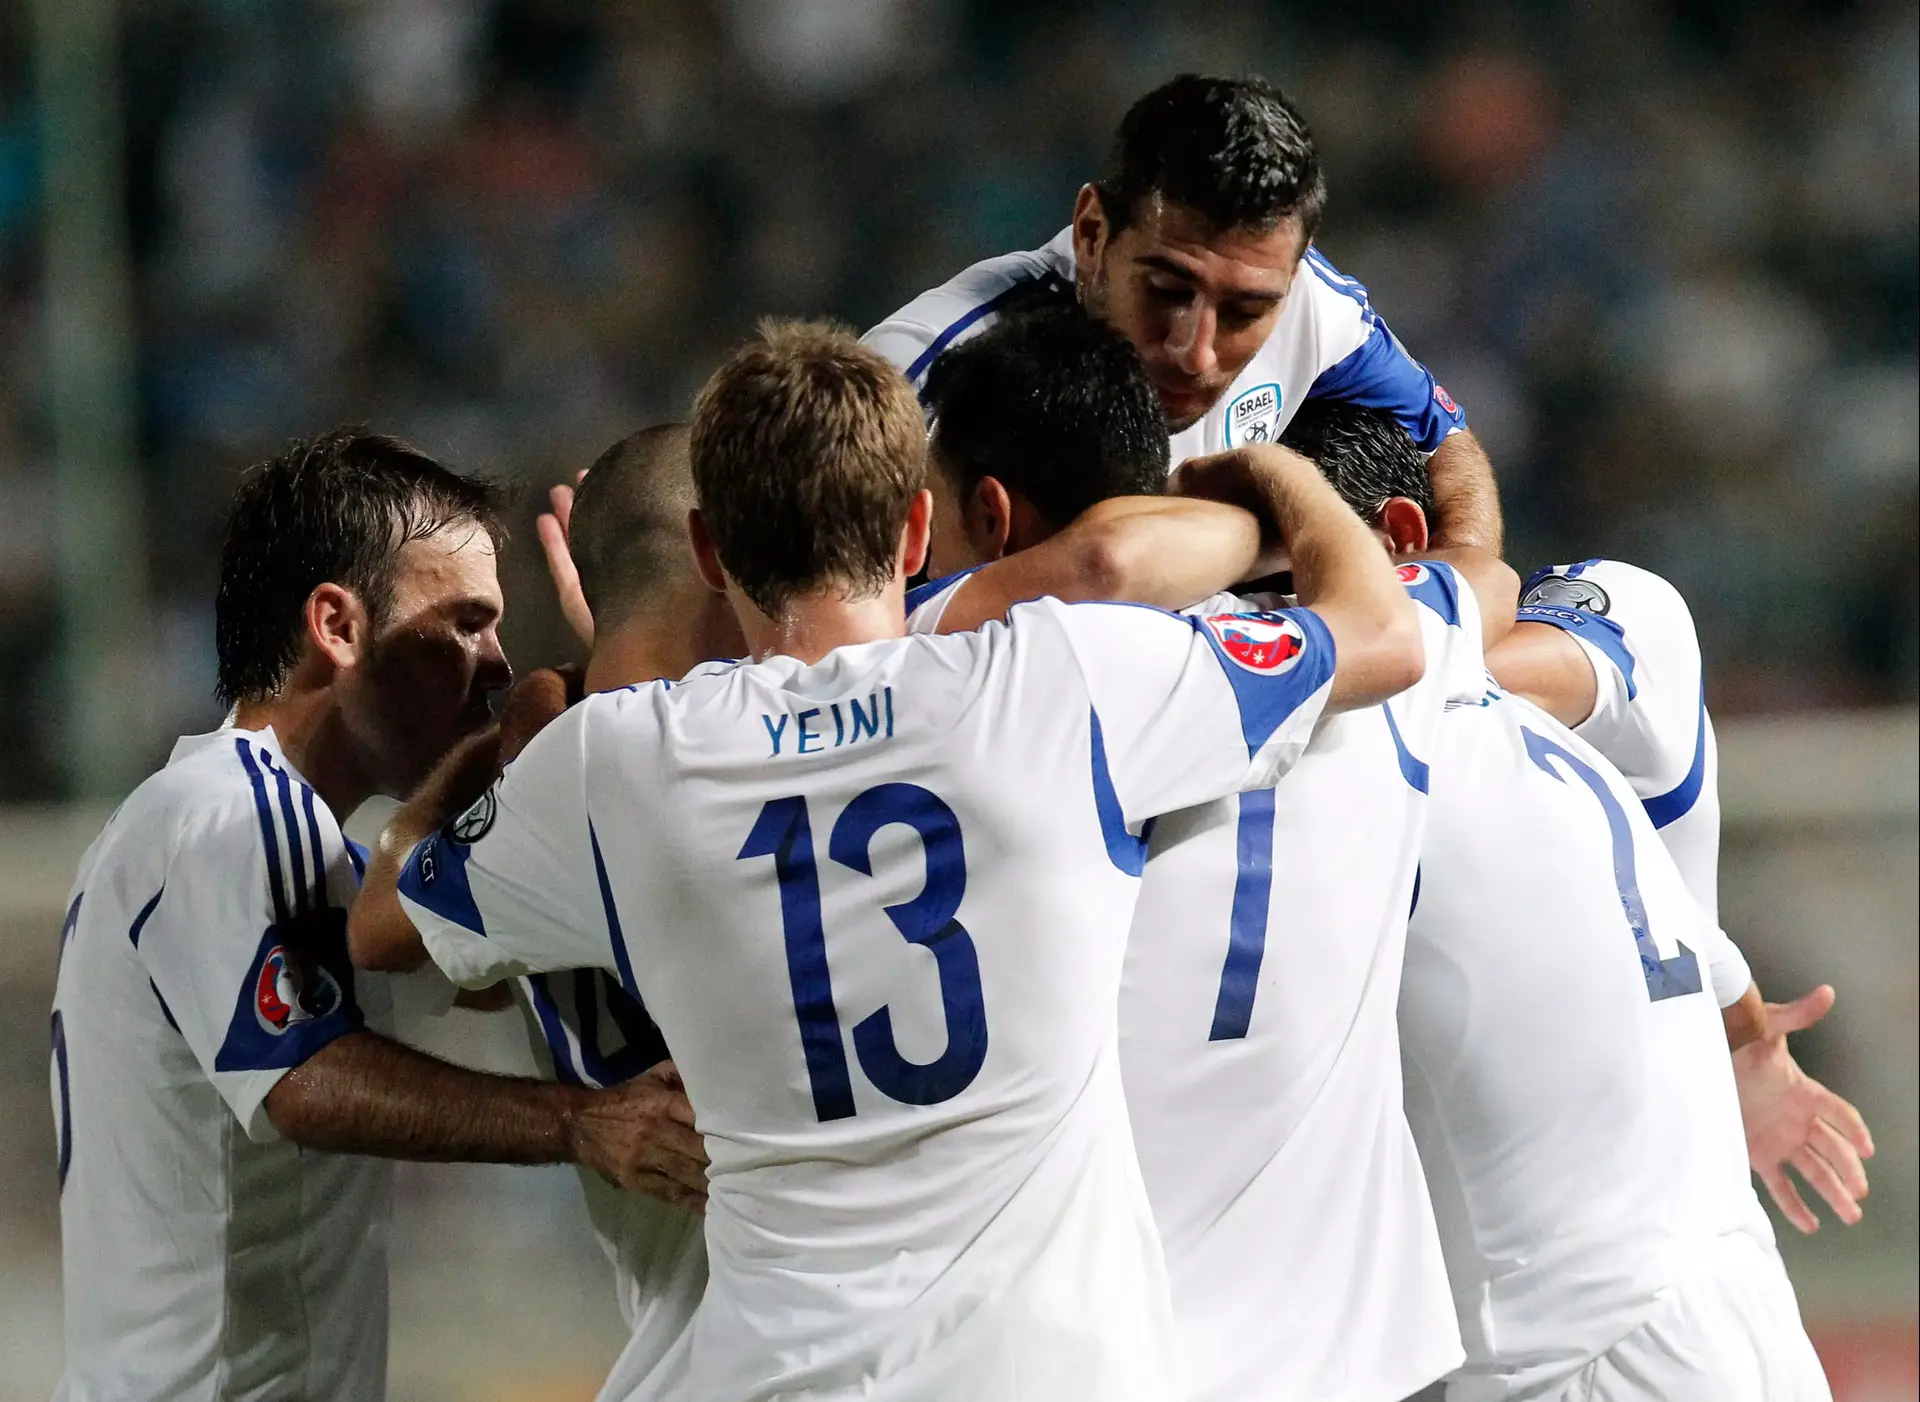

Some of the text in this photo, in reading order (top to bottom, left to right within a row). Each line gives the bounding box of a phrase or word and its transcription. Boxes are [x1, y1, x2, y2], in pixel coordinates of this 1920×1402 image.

[1235, 391, 1273, 418] ISRAEL
[1518, 605, 1586, 627] SPECT
[763, 687, 894, 758] YEINI
[1520, 724, 1702, 1002] 2
[736, 782, 988, 1122] 13
